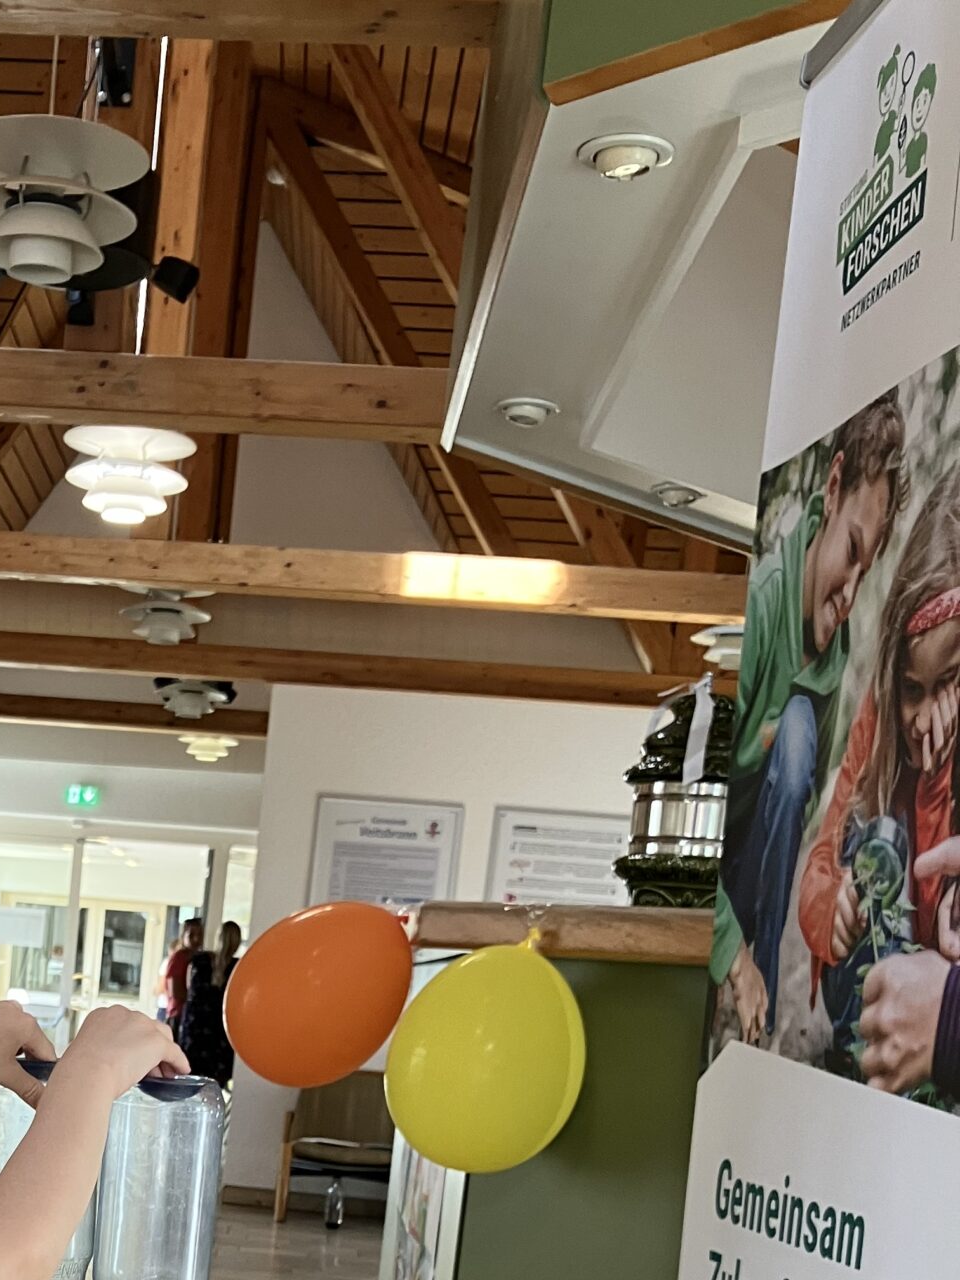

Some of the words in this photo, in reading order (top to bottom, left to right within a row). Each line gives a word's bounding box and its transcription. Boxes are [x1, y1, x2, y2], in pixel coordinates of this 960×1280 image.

[840, 163, 890, 255] KINDER
[845, 181, 923, 288] FORSCHEN
[840, 250, 921, 332] NETZWERKPARTNER
[715, 1158, 866, 1271] Gemeinsam
